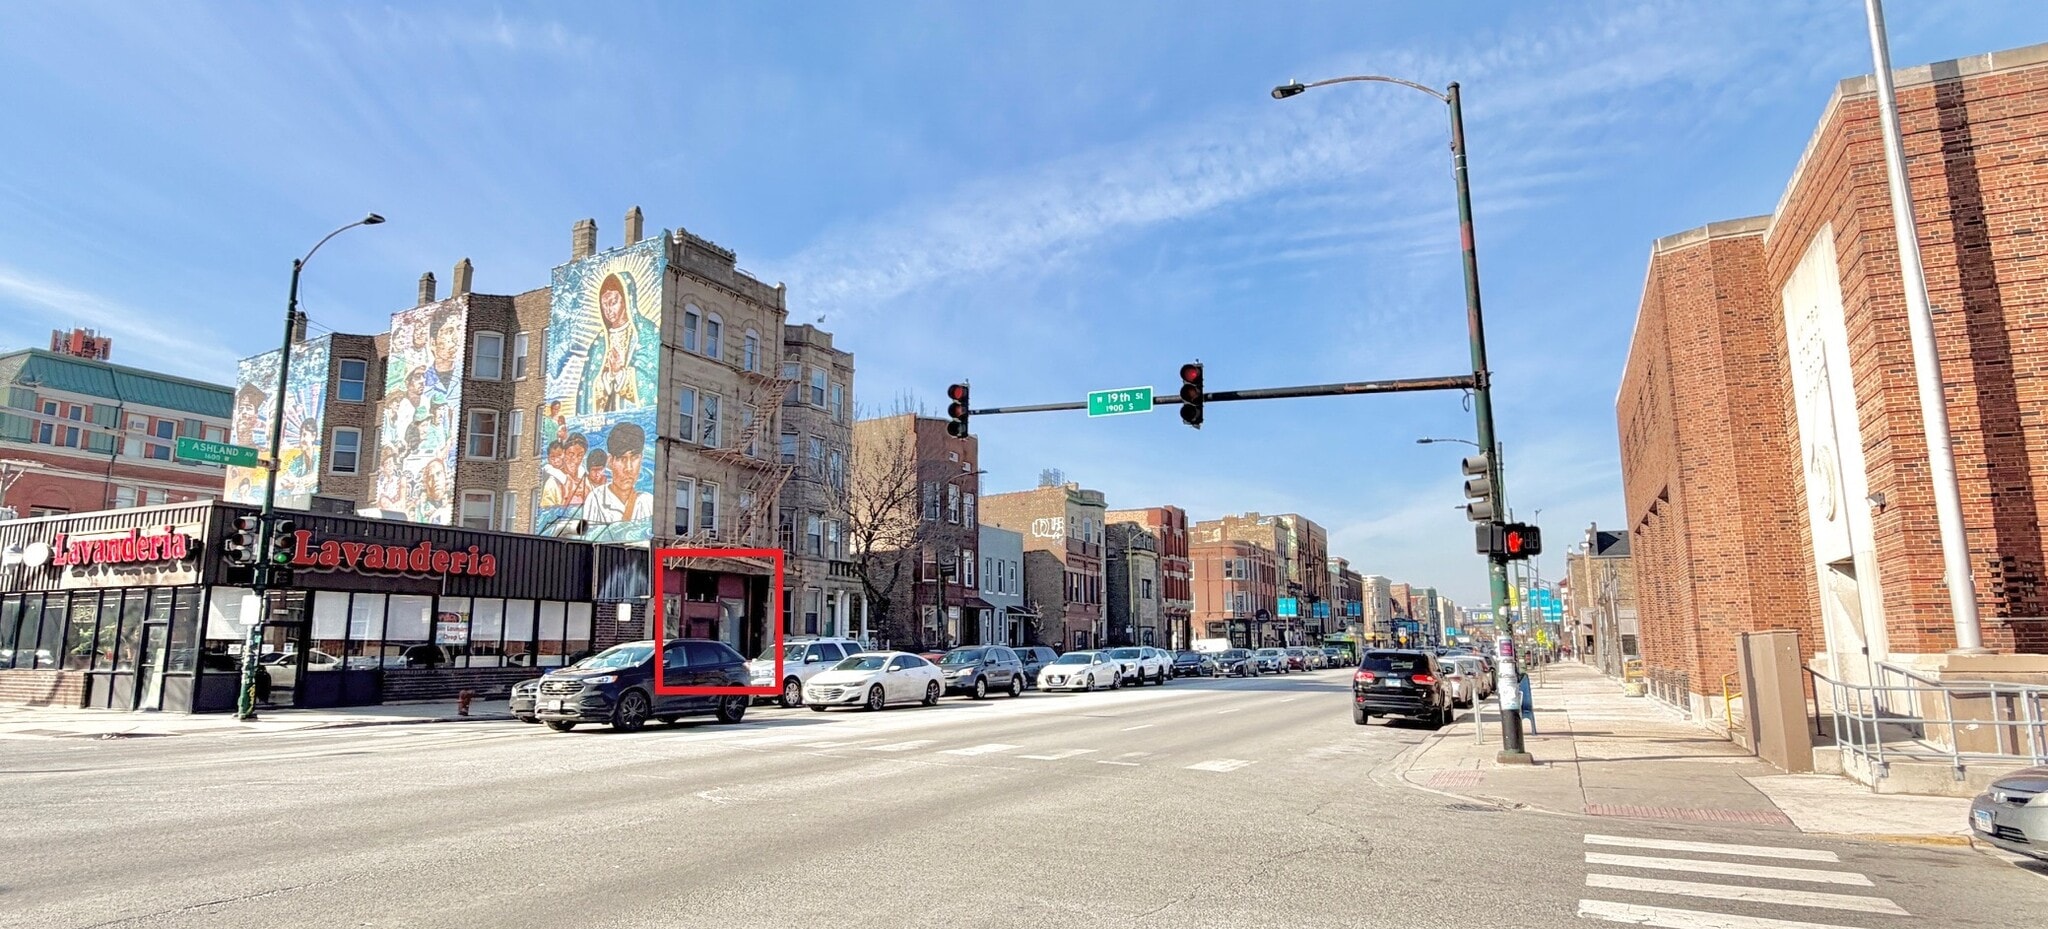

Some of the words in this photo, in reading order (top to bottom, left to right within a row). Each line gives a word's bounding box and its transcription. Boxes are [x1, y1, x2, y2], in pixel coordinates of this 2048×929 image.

[1107, 392, 1131, 404] 19th
[1135, 392, 1144, 400] St
[1105, 404, 1124, 412] 1900
[1128, 402, 1134, 411] S
[191, 442, 240, 457] ASHLAND
[204, 452, 221, 461] 1600
[53, 525, 186, 566] Lavanderia
[292, 529, 496, 577] Lavanderia
